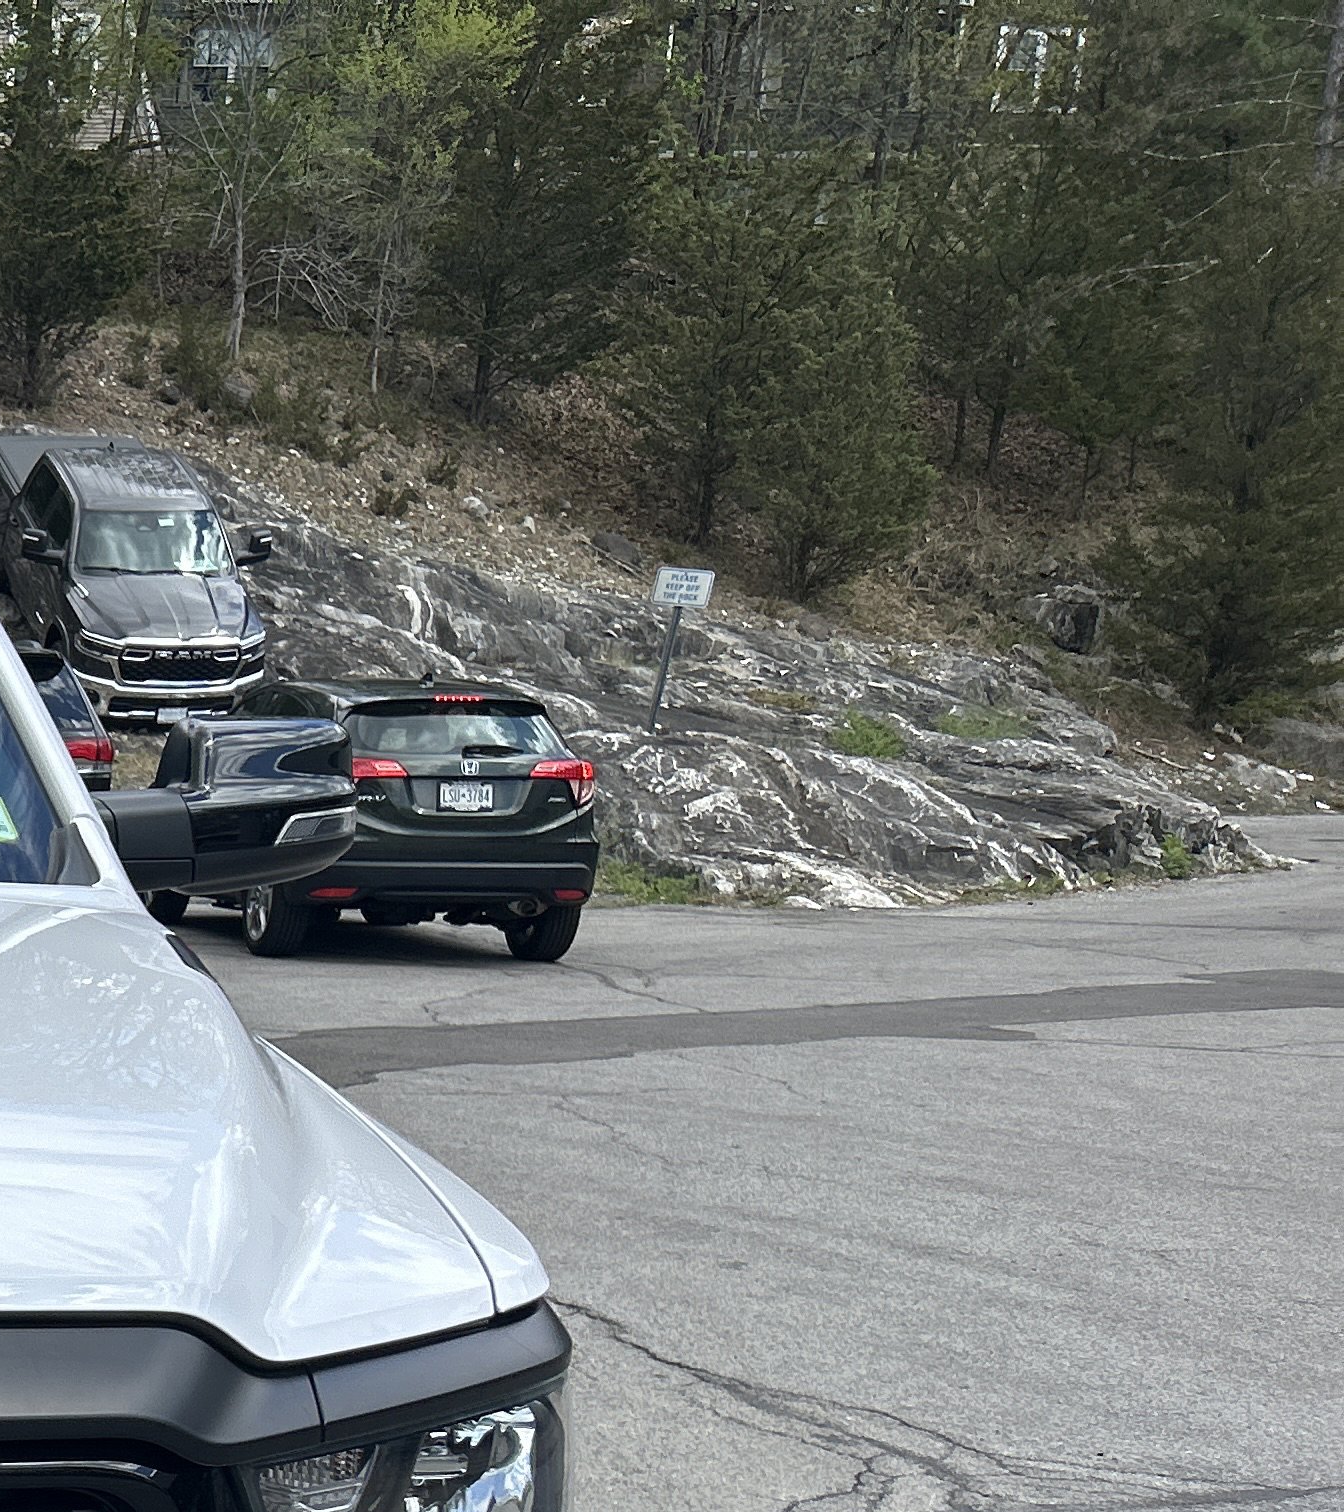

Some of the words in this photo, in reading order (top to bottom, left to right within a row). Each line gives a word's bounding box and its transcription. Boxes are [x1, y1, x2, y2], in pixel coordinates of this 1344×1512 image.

[671, 573, 699, 582] PLEASE
[665, 583, 684, 591] KEEP
[686, 584, 700, 592] OFF
[663, 591, 676, 600] THE
[678, 593, 698, 601] ROCK
[154, 650, 212, 660] RAM
